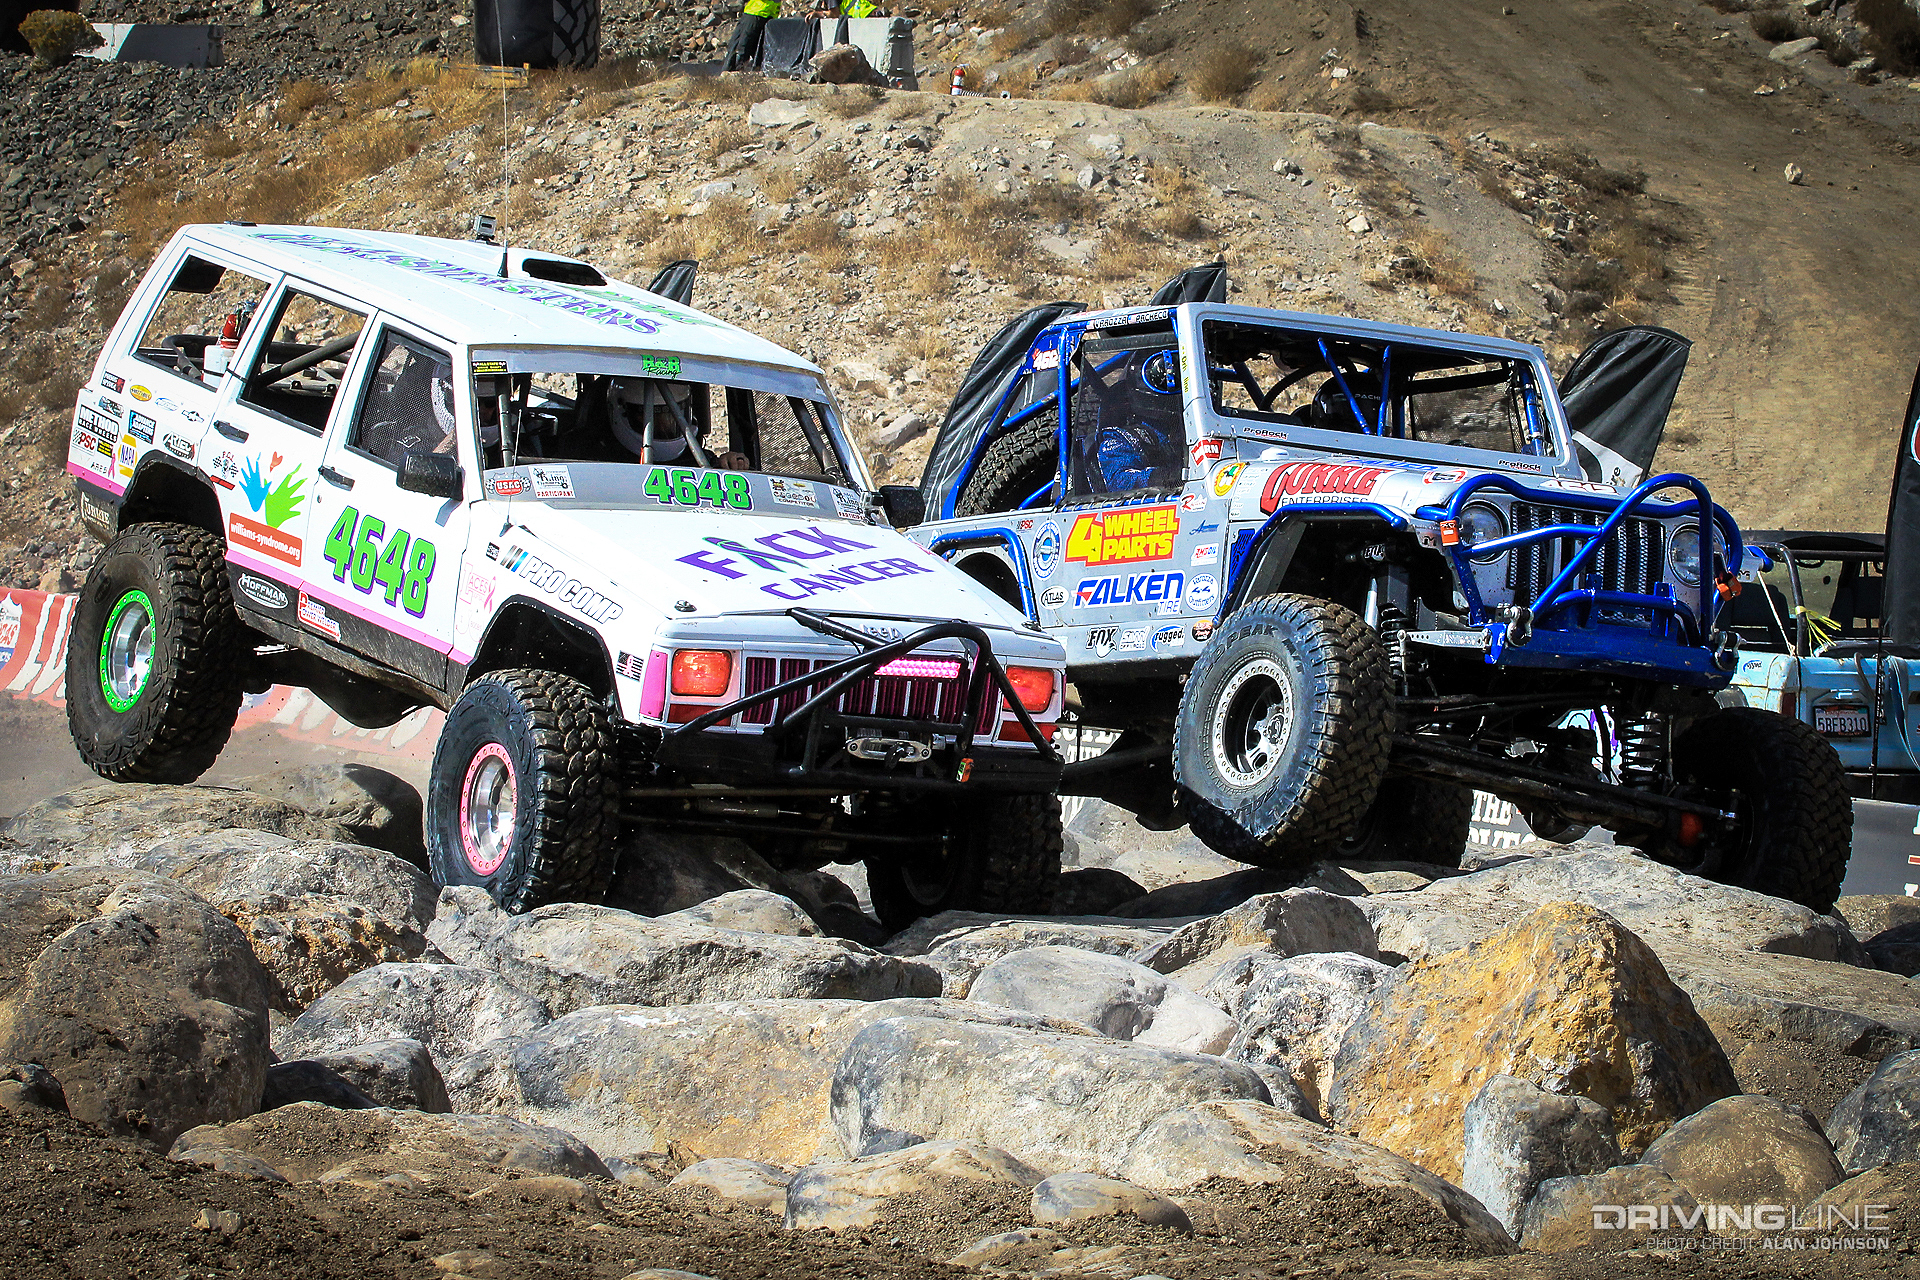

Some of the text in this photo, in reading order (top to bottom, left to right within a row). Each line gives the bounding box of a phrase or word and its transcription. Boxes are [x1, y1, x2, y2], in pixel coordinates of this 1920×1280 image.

[80, 405, 118, 433] METHOD
[644, 468, 753, 512] 4648
[230, 522, 301, 560] williams-syndrome.org
[1066, 516, 1103, 564] 4
[1104, 508, 1178, 537] WHEEL
[1102, 533, 1173, 562] PARTS
[324, 505, 436, 619] 4648
[759, 558, 930, 601] CANCER
[241, 572, 286, 601] HOFFMAN
[518, 555, 624, 624] PRO COMP
[1044, 592, 1064, 602] ATLAS
[1075, 572, 1183, 607] FALKEN
[1157, 600, 1180, 615] TIRE
